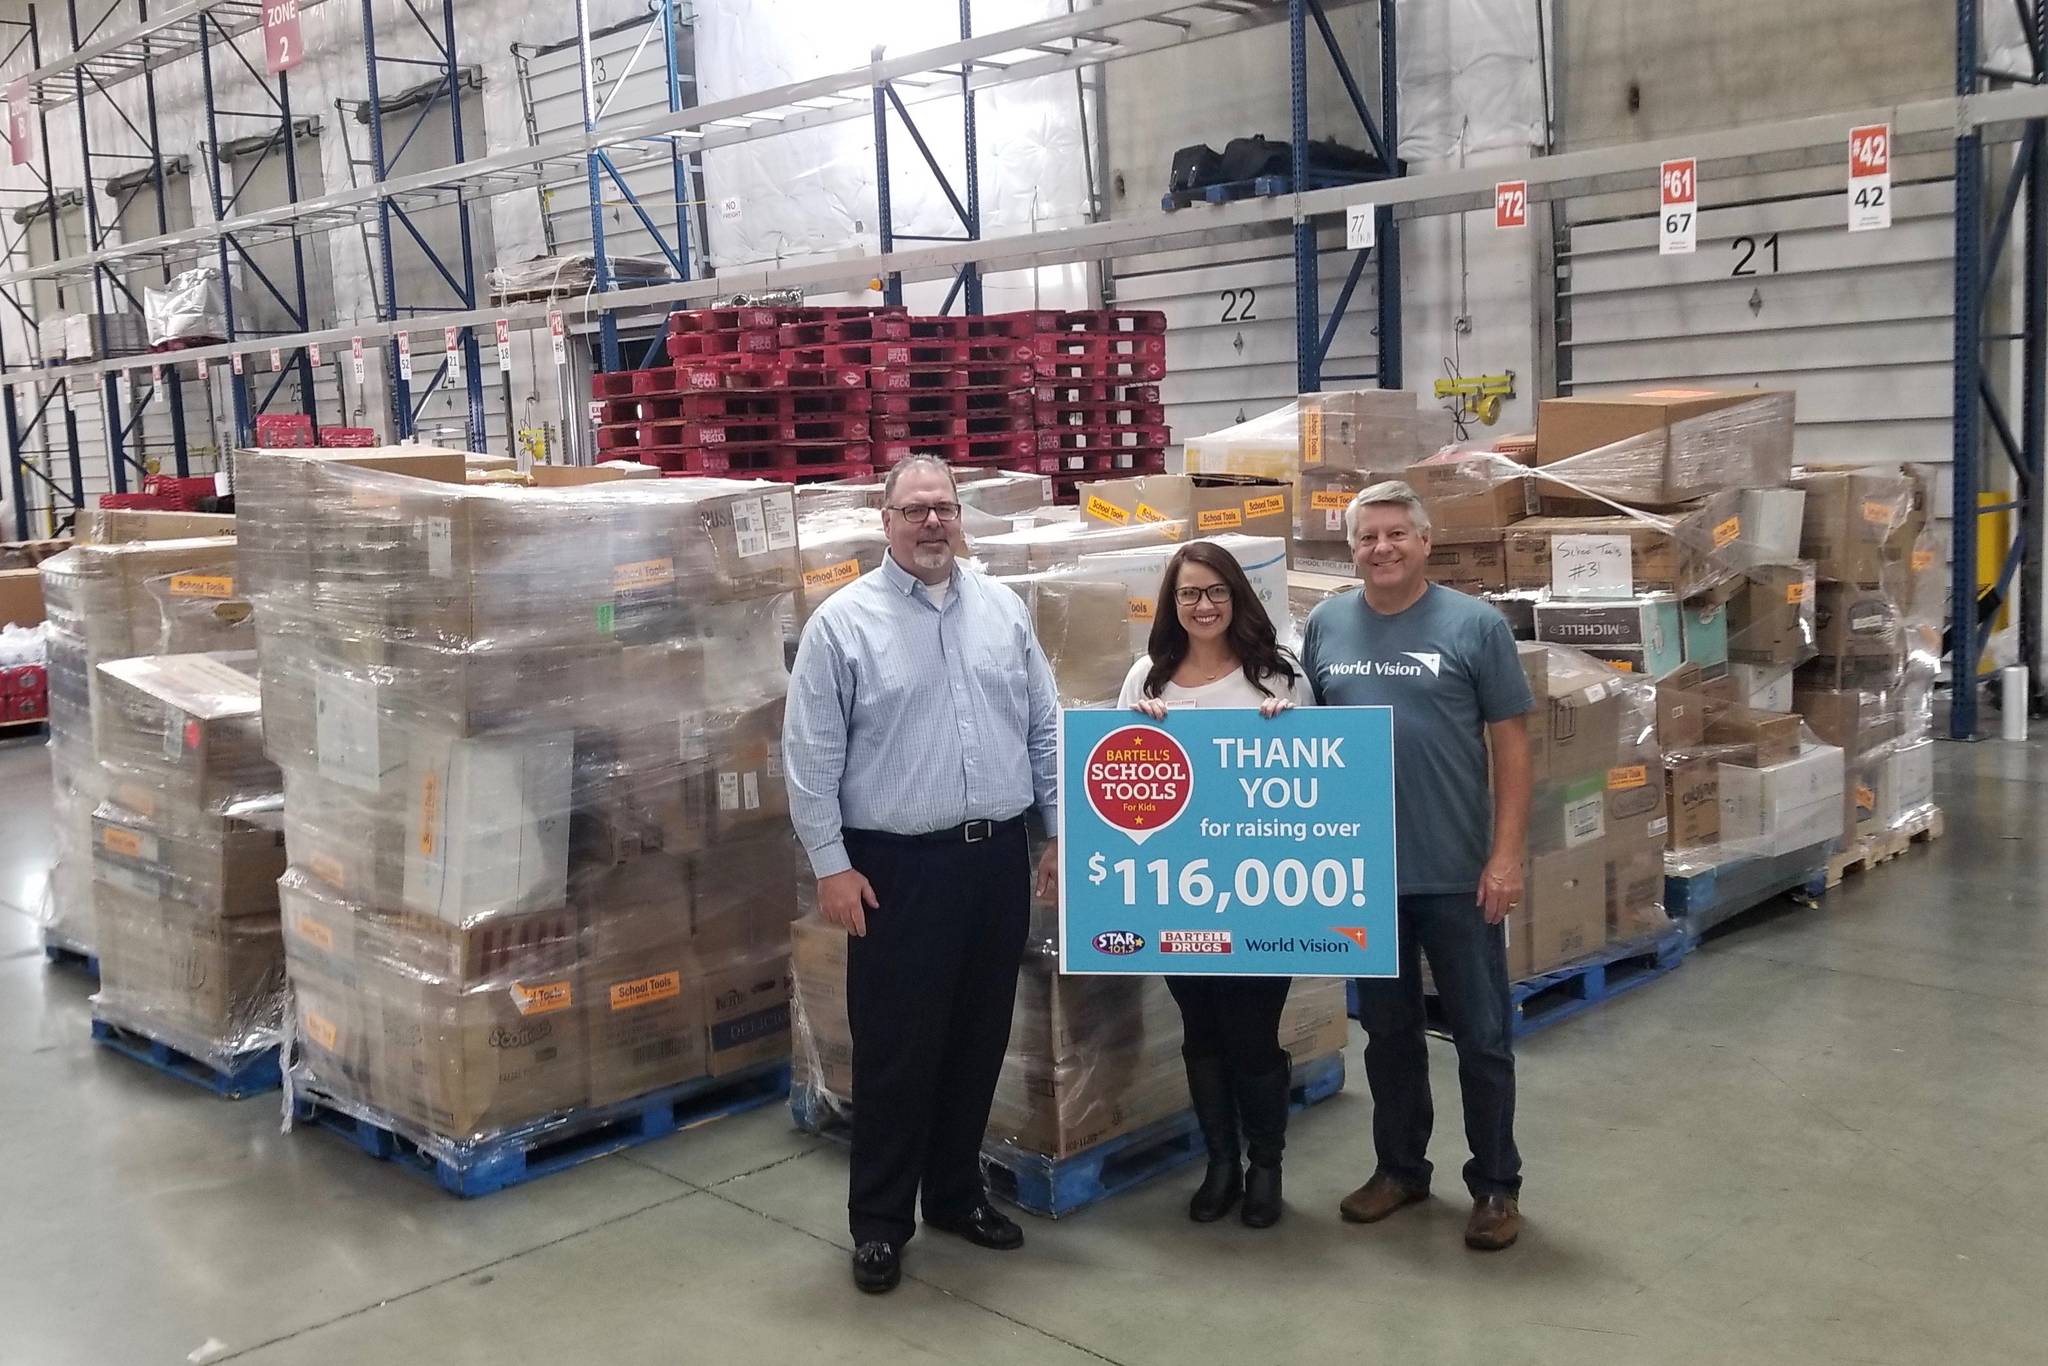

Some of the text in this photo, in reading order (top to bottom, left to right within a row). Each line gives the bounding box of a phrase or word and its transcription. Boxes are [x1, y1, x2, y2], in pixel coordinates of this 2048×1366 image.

[267, 6, 296, 27] ZONE
[279, 36, 289, 63] 2
[1852, 135, 1886, 167] #42
[1664, 173, 1691, 199] #61
[725, 201, 736, 209] NO
[1498, 191, 1523, 217] #72
[1854, 186, 1883, 208] 42
[1665, 213, 1691, 233] 67
[1731, 233, 1780, 276] 21
[1221, 288, 1256, 323] 22
[448, 355, 457, 366] 21
[500, 348, 509, 360] 18
[402, 361, 410, 370] 52
[1249, 498, 1280, 511] School Tools
[1317, 495, 1338, 503] School
[1093, 499, 1124, 519] School Tools
[1204, 512, 1236, 522] School Tools
[806, 563, 852, 584] School Tools
[1568, 561, 1599, 580] #3
[1129, 601, 1147, 612] ools
[1559, 624, 1619, 635] MICHELLE
[1329, 660, 1421, 676] World Vision
[1106, 749, 1170, 761] BARTELL'S
[1212, 737, 1346, 769] THANK
[1091, 763, 1186, 782] SCHOOL
[1101, 783, 1177, 800] TOOLS
[1238, 777, 1319, 809] YOU
[1122, 803, 1156, 812] For Kids
[1200, 817, 1361, 842] for raising over
[1088, 851, 1367, 914] $116,000!
[1098, 932, 1135, 948] STAR
[1165, 932, 1228, 943] BARTELL
[1245, 938, 1350, 953] World Vision
[1108, 944, 1135, 955] 101.5
[1171, 942, 1223, 953] DRUGS
[618, 976, 672, 998] School Tools
